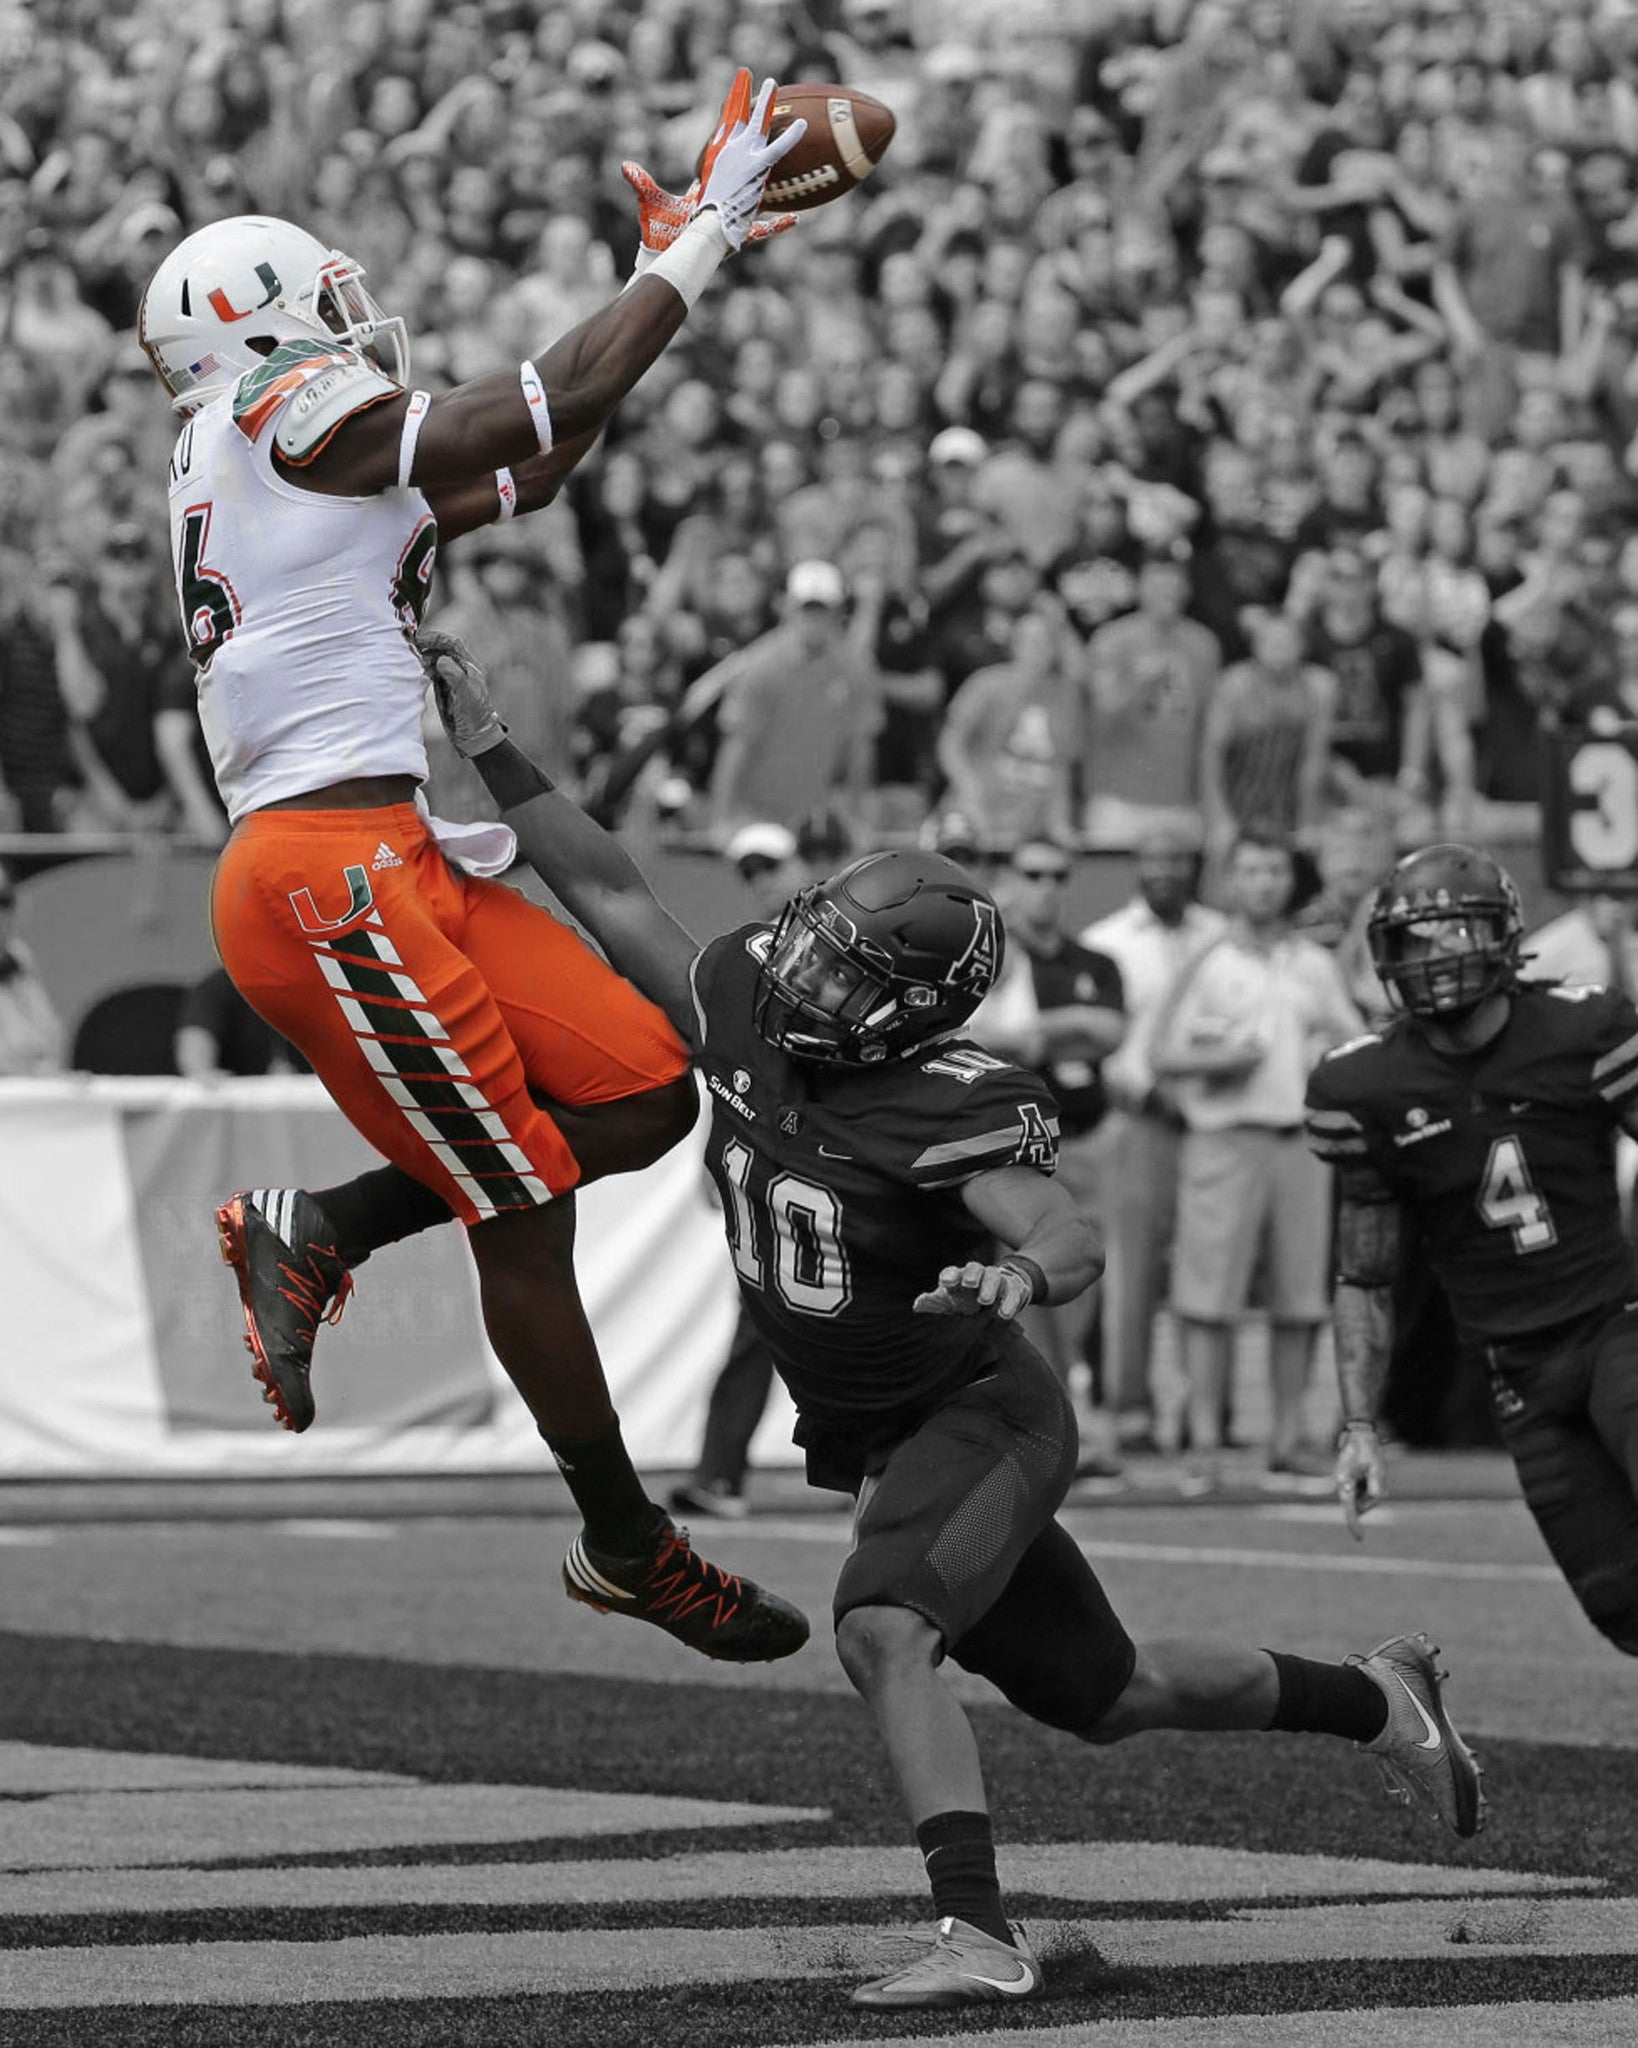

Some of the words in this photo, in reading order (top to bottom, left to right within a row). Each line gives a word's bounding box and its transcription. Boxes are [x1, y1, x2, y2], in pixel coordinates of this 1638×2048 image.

[1568, 741, 1638, 870] 3
[288, 864, 373, 933] U
[721, 1134, 853, 1317] 10
[1474, 1133, 1559, 1255] 4
